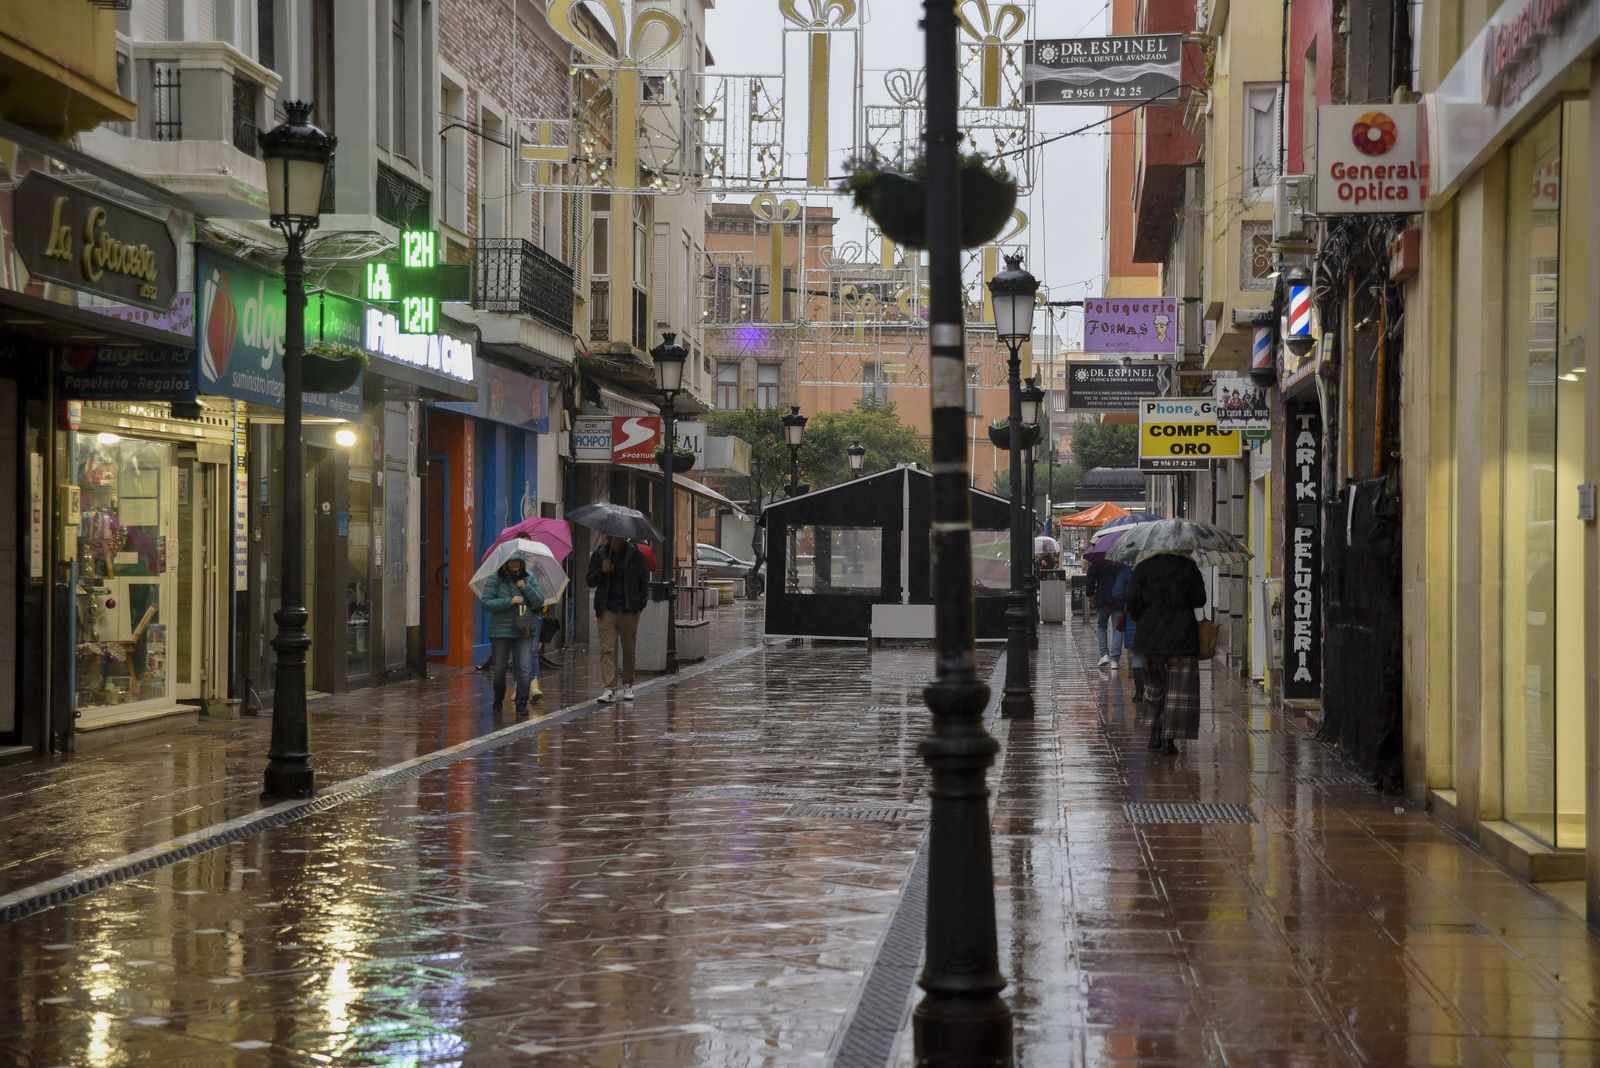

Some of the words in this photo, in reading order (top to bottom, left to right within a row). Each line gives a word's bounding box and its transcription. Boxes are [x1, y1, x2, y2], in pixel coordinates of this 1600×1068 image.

[1091, 39, 1168, 54] ESPINEL
[1061, 55, 1092, 64] CLÍNICA
[1094, 55, 1124, 63] DENTAL
[1126, 53, 1167, 62] AVANZADA
[1076, 88, 1095, 98] 956
[1099, 88, 1110, 97] 17
[1113, 87, 1126, 97] 42
[1129, 86, 1142, 96] 25
[1330, 161, 1417, 180] General
[1337, 182, 1408, 205] Optica
[47, 196, 73, 261] La
[402, 231, 435, 268] 12H
[402, 297, 434, 333] 12H
[1108, 368, 1154, 378] ESPINEL
[137, 375, 190, 393] Regalos
[1147, 403, 1193, 414] Phone
[573, 435, 611, 447] JACKPOT
[1170, 443, 1212, 455] ORO
[620, 452, 656, 460] SPORTIUM
[1296, 414, 1316, 500] TARIK
[1294, 527, 1312, 682] PELUQUERIA
